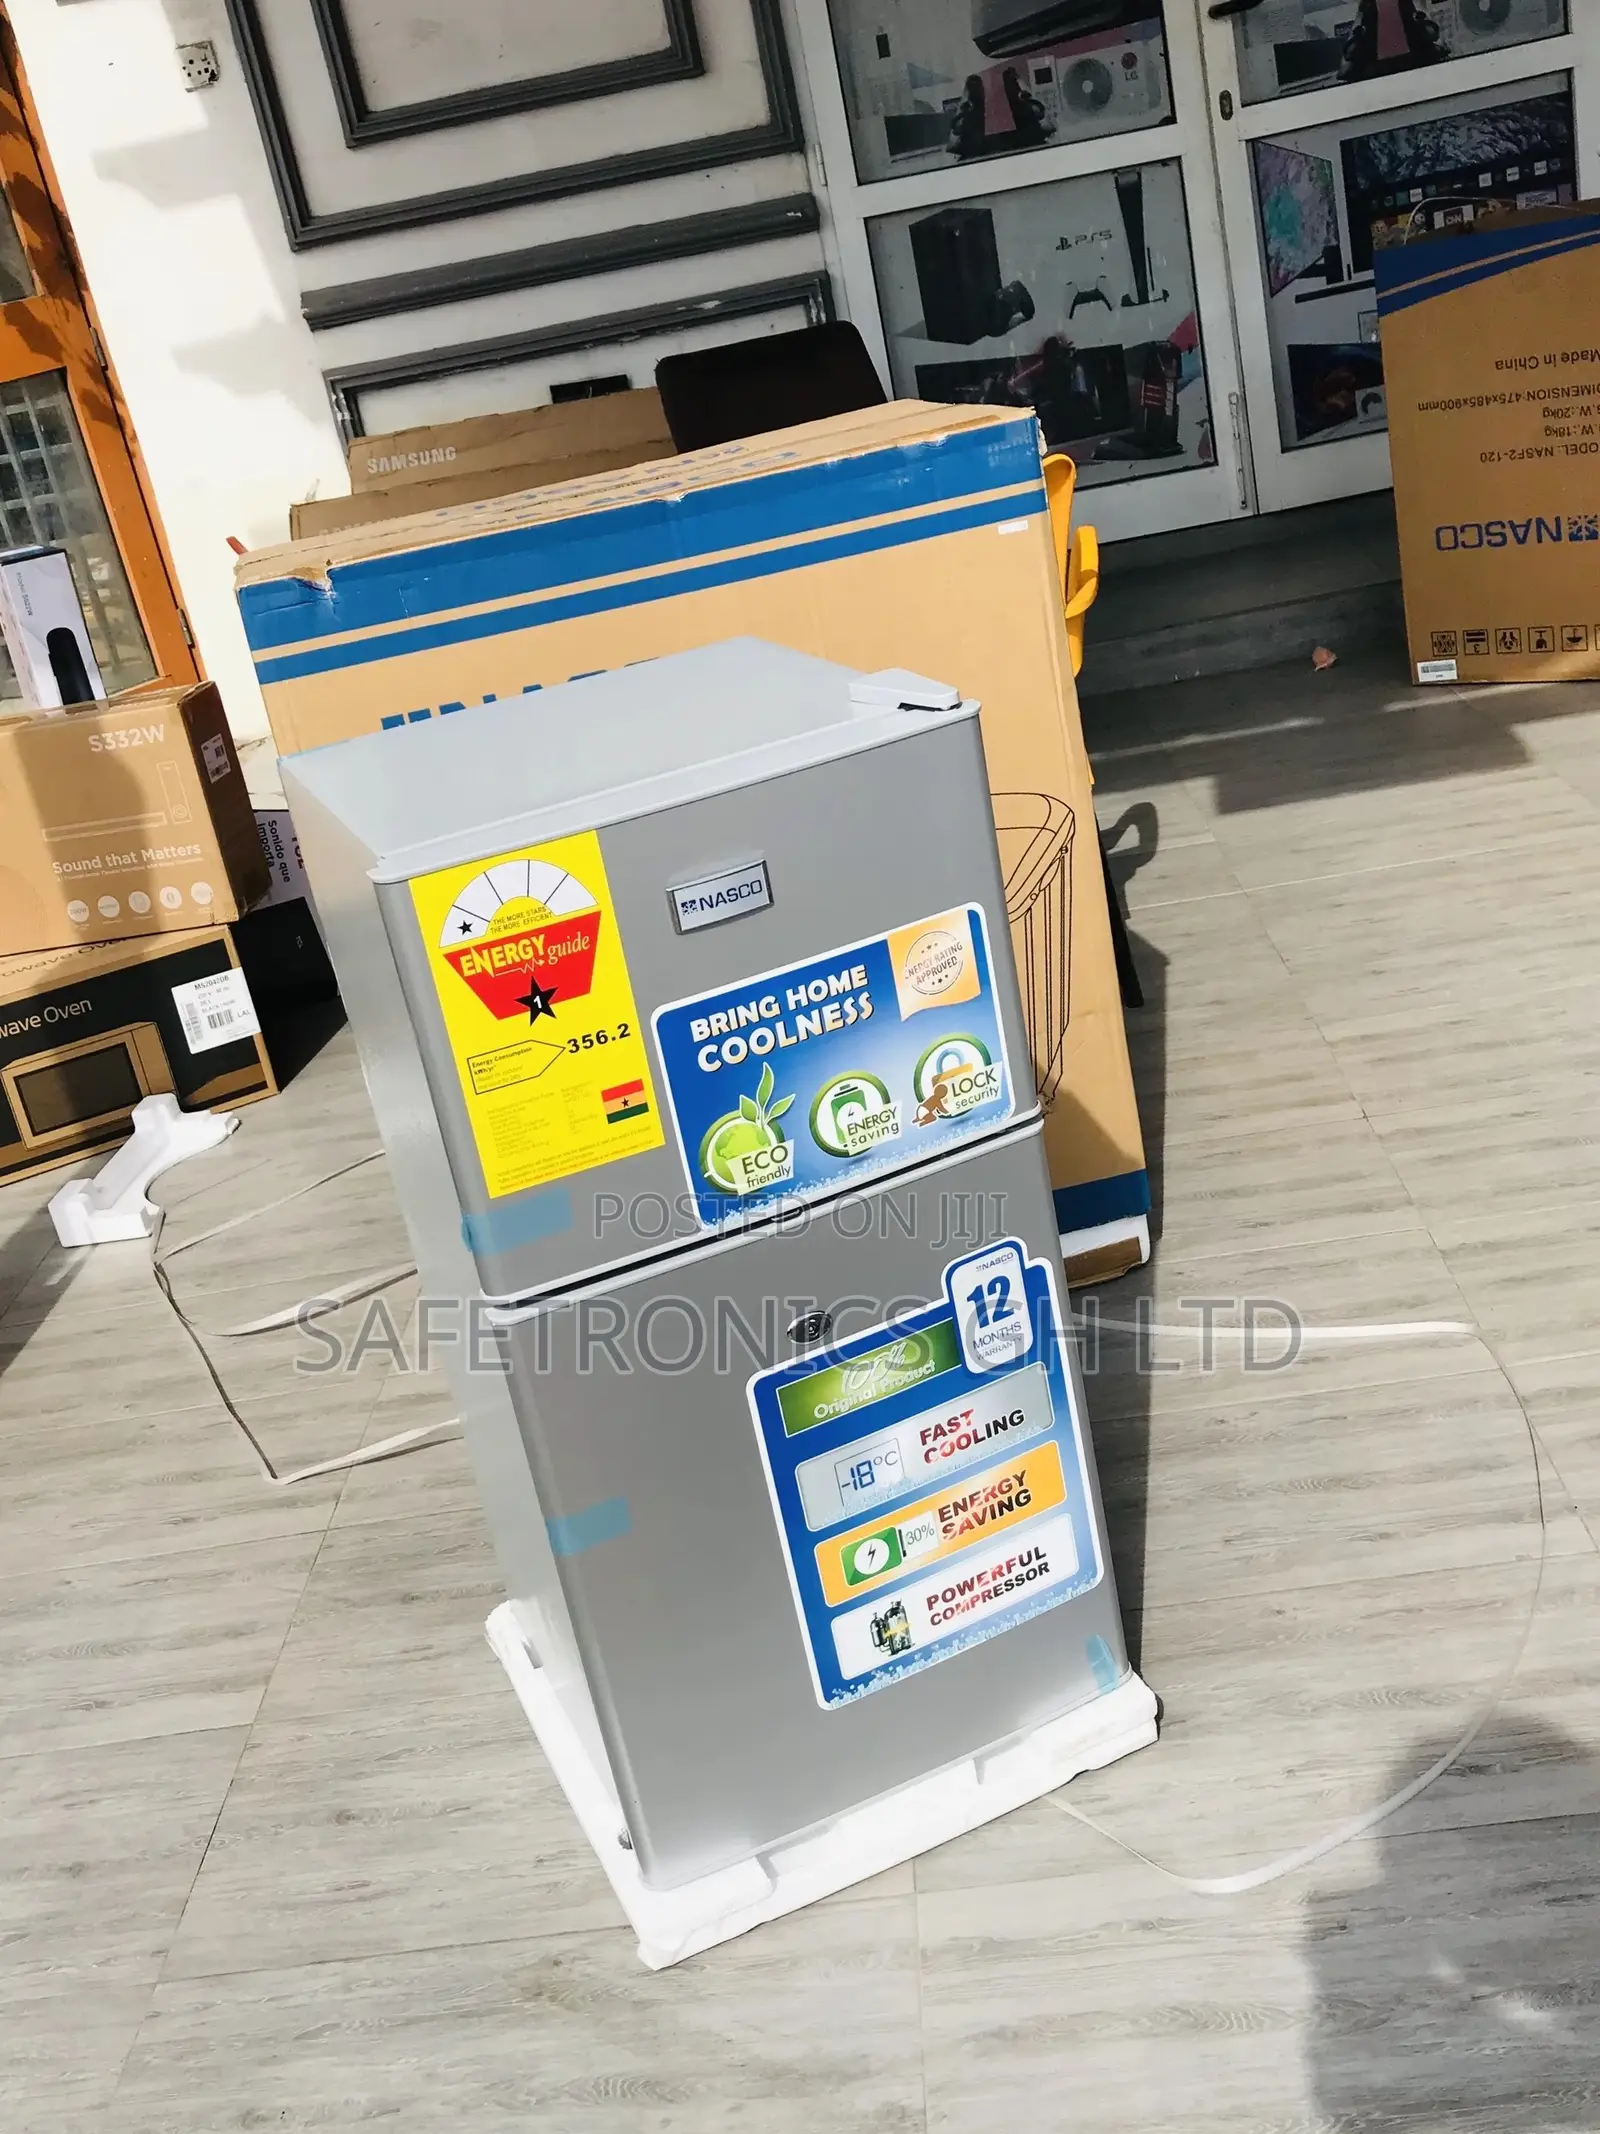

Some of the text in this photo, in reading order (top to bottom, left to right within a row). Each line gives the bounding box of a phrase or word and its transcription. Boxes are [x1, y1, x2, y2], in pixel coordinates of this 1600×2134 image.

[1074, 229, 1112, 245] PS5
[1495, 355, 1539, 371] China
[1543, 352, 1557, 367] in
[367, 446, 456, 475] SAMSUNG
[1480, 446, 1553, 463] NASF2-120
[1435, 516, 1562, 551] NASCO
[88, 723, 165, 753] S332W
[52, 856, 102, 875] Sound
[105, 850, 138, 867] that
[141, 843, 202, 863] Matters
[257, 822, 275, 868] Importa
[268, 819, 291, 883] Sonido que
[699, 879, 763, 911] NASCO
[490, 912, 552, 935] THE MORE EFFICIENT
[493, 906, 547, 925] THE MORE STARS
[459, 931, 591, 978] ENERGY guide
[934, 941, 963, 963] RATING
[916, 955, 958, 985] APPROVED
[43, 999, 93, 1023] Oven
[533, 995, 543, 1009] 1
[690, 964, 869, 1043] BRING HOME
[566, 1022, 631, 1054] 356.2
[697, 991, 875, 1073] COOLNESS
[472, 1047, 532, 1069] Energy Consumption
[951, 1067, 998, 1098] LOCK
[955, 1084, 1000, 1110] security
[847, 1107, 898, 1137] ENERGY
[851, 1121, 900, 1148] saving
[741, 1144, 788, 1175] ECO
[746, 1164, 792, 1189] friendly
[982, 1252, 1014, 1270] NASCO
[966, 1275, 1015, 1330] 12
[972, 1321, 1022, 1350] MONTHS
[976, 1335, 1023, 1361] WARRANTY
[842, 1341, 909, 1395] 100%
[813, 1358, 936, 1419] Original Product
[919, 1408, 975, 1446] FAST
[923, 1409, 1025, 1465] COOLING
[938, 1469, 1027, 1523] ENERGY
[941, 1488, 1032, 1541] SAVING
[905, 1523, 935, 1546] 30%
[926, 1545, 1047, 1611] POWERFUL
[930, 1561, 1051, 1627] COMPRESSOR
